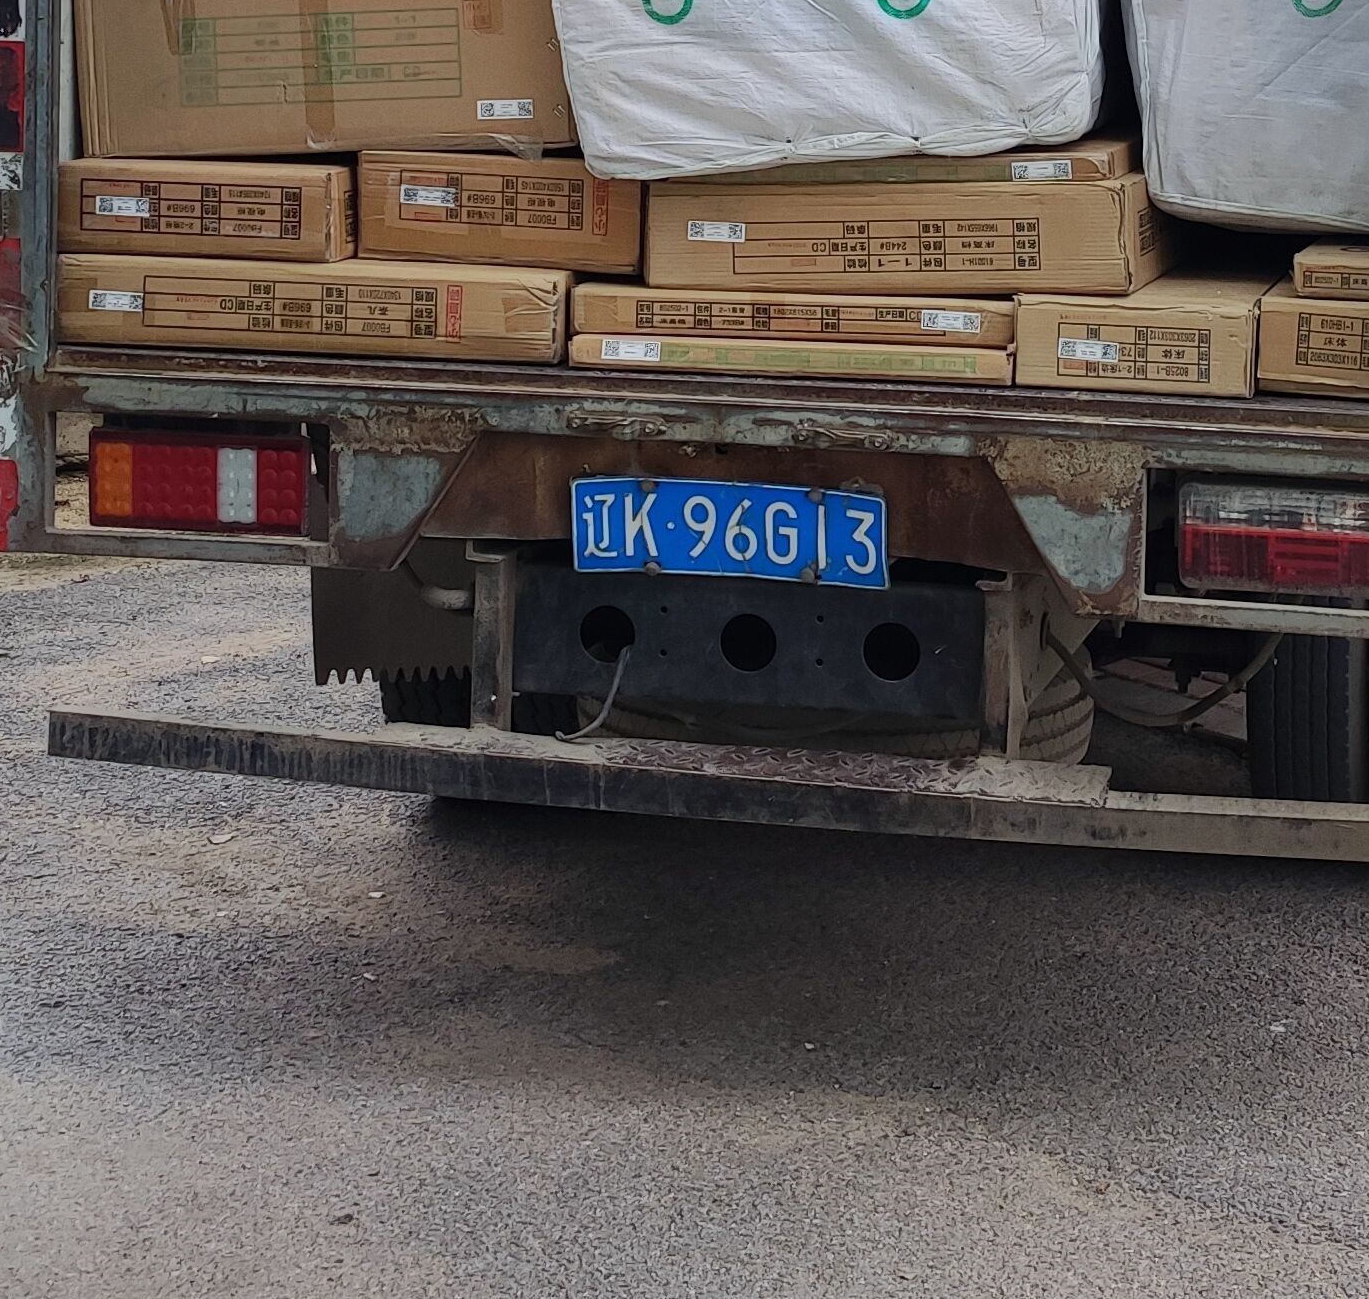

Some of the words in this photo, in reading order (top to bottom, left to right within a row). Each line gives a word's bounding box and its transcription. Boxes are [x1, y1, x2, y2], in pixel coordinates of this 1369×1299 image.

[467, 194, 495, 204] 696B#
[527, 198, 555, 206] 电视柜
[528, 214, 557, 225] FB0007
[922, 224, 941, 233] 毛重
[1016, 222, 1036, 233] 规格
[812, 243, 826, 252] CD
[831, 242, 866, 252] 生产日期
[880, 242, 907, 251] 244B#
[922, 241, 942, 251] 颜色
[1016, 239, 1036, 249] 名称
[847, 259, 867, 268] 检验
[922, 257, 942, 267] 包件
[1018, 256, 1037, 267] 型号
[326, 287, 344, 298] 毛重
[415, 291, 434, 302] 规格
[220, 299, 234, 309] CD
[237, 300, 272, 311] 生产日期
[282, 302, 312, 312] 696B#
[325, 304, 344, 314] 颜色
[367, 306, 388, 315] 茶几
[415, 307, 433, 318] 名称
[878, 310, 905, 319] 生产日期
[252, 317, 270, 327] 检验
[325, 320, 343, 332] 包件
[414, 324, 433, 335] 型号
[1323, 338, 1347, 347] 床体
[1119, 347, 1132, 356] 73
[1162, 349, 1185, 359] 床体
